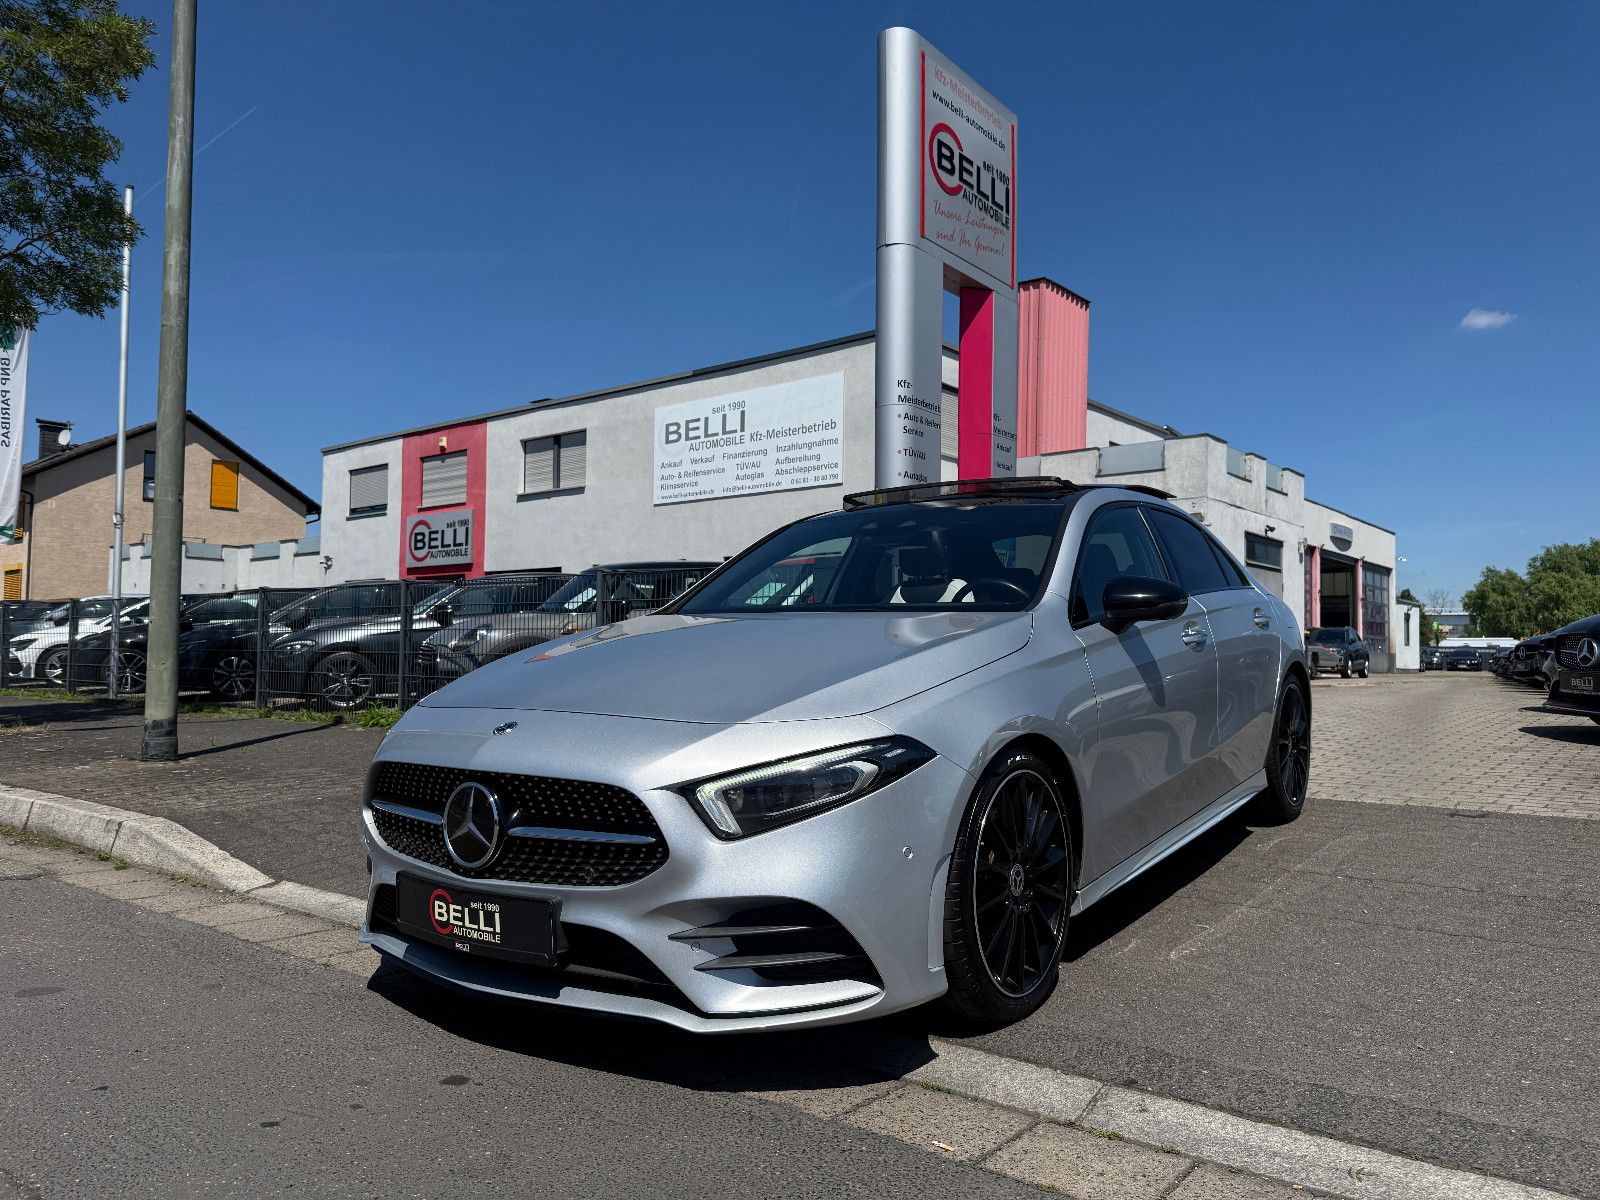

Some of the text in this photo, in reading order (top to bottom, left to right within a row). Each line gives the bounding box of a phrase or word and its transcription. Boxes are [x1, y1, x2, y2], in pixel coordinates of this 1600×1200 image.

[937, 137, 1010, 216] BELLI
[962, 188, 1010, 231] AUTOMOBILE
[897, 379, 913, 389] Kfz-
[711, 400, 746, 415] seit 1990
[664, 409, 746, 445] BELLI
[688, 418, 837, 453] AUTOMOBILE Kfz-Meisterbetrieb
[660, 437, 839, 469] Ankauf Verkauf Finanzierung Inzahlungnahme
[683, 467, 726, 478] Reifenservice
[775, 453, 821, 466] Aufbereitung
[660, 462, 839, 491] Klimaservice Autoglas Abschleppservice
[414, 527, 468, 550] BELLI
[430, 548, 468, 558] AUTOMOBILE
[434, 900, 500, 933] BELLI
[470, 901, 500, 912] seit 1990
[453, 925, 500, 943] AUTOMOBILE
